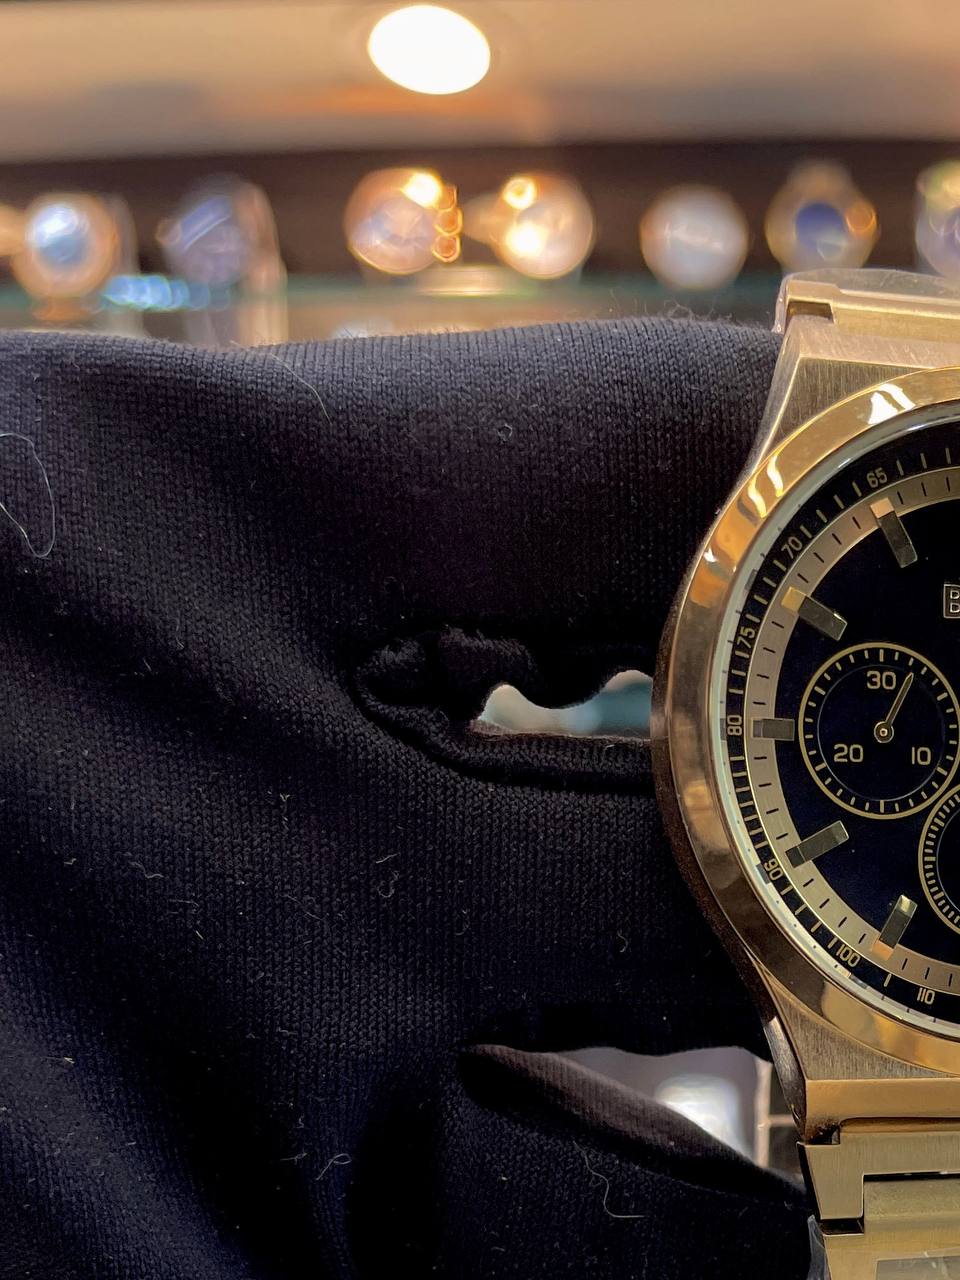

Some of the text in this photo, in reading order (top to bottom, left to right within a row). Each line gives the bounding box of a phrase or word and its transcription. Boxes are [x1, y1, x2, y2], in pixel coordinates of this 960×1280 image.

[866, 467, 888, 488] 65
[781, 535, 803, 559] 70
[737, 626, 756, 648] 75
[866, 670, 897, 690] 30
[727, 714, 743, 736] 80
[833, 743, 864, 763] 20
[911, 746, 932, 766] 10
[763, 858, 783, 881] 90
[835, 946, 861, 968] 100
[916, 987, 936, 1005] 110
